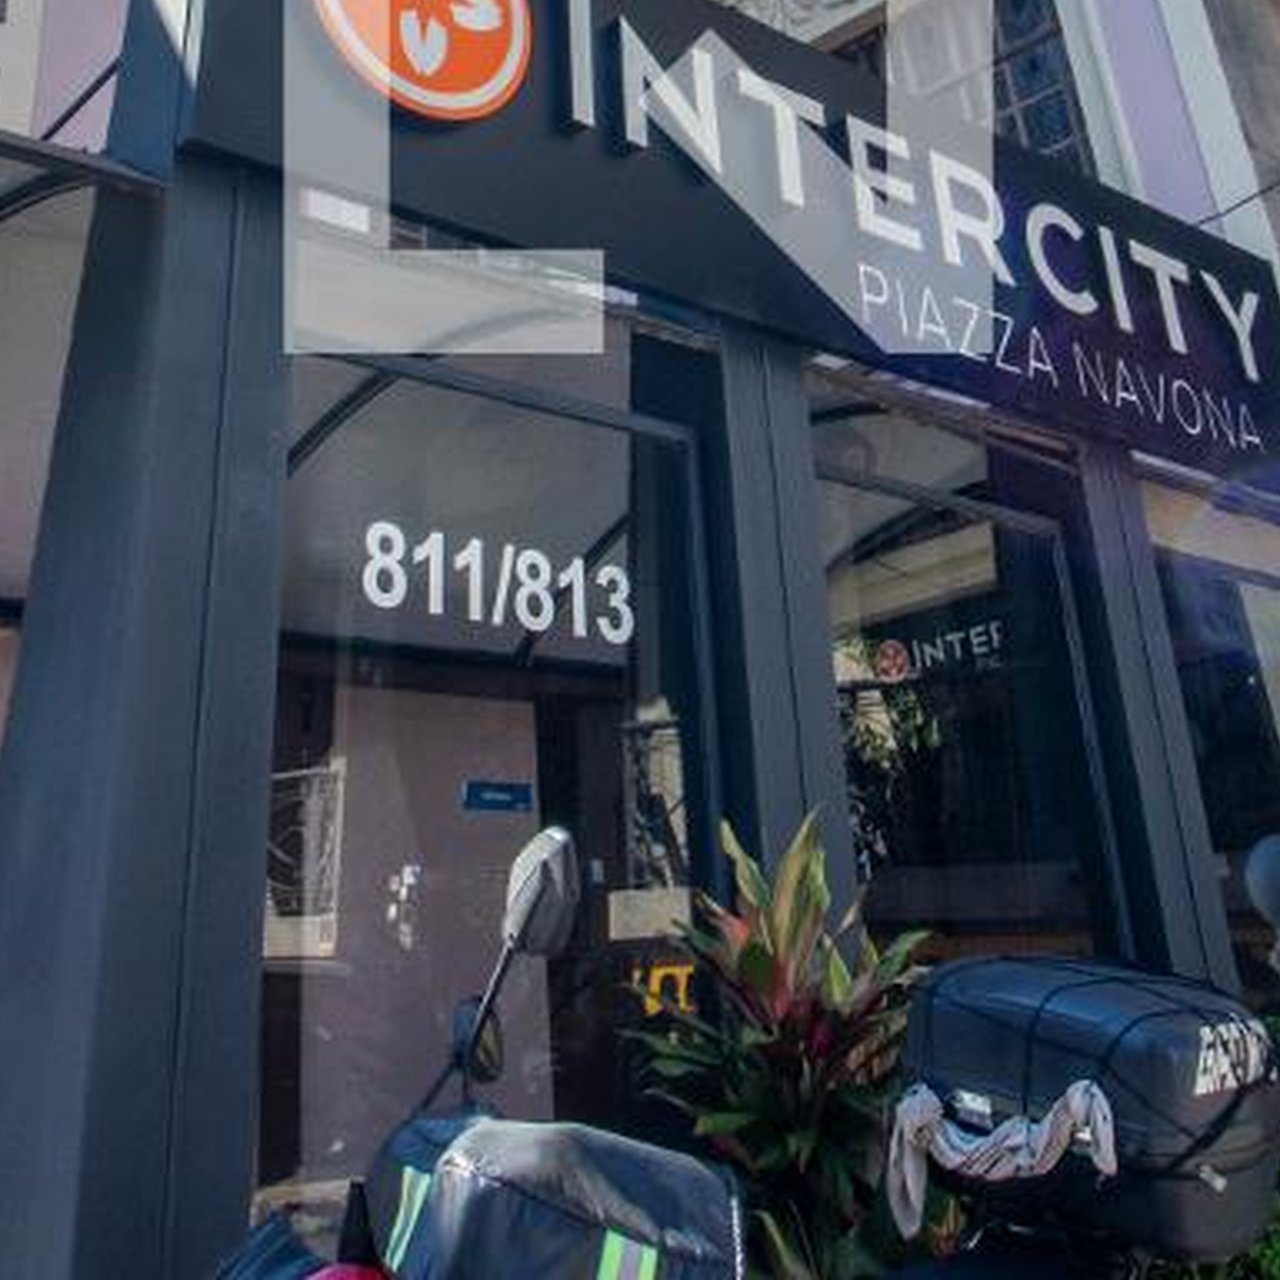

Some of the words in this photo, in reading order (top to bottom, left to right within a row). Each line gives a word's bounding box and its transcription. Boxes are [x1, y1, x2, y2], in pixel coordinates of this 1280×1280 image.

[856, 263, 1059, 389] PIAZZA
[1074, 342, 1264, 451] NAVONA
[362, 521, 634, 645] 811/813
